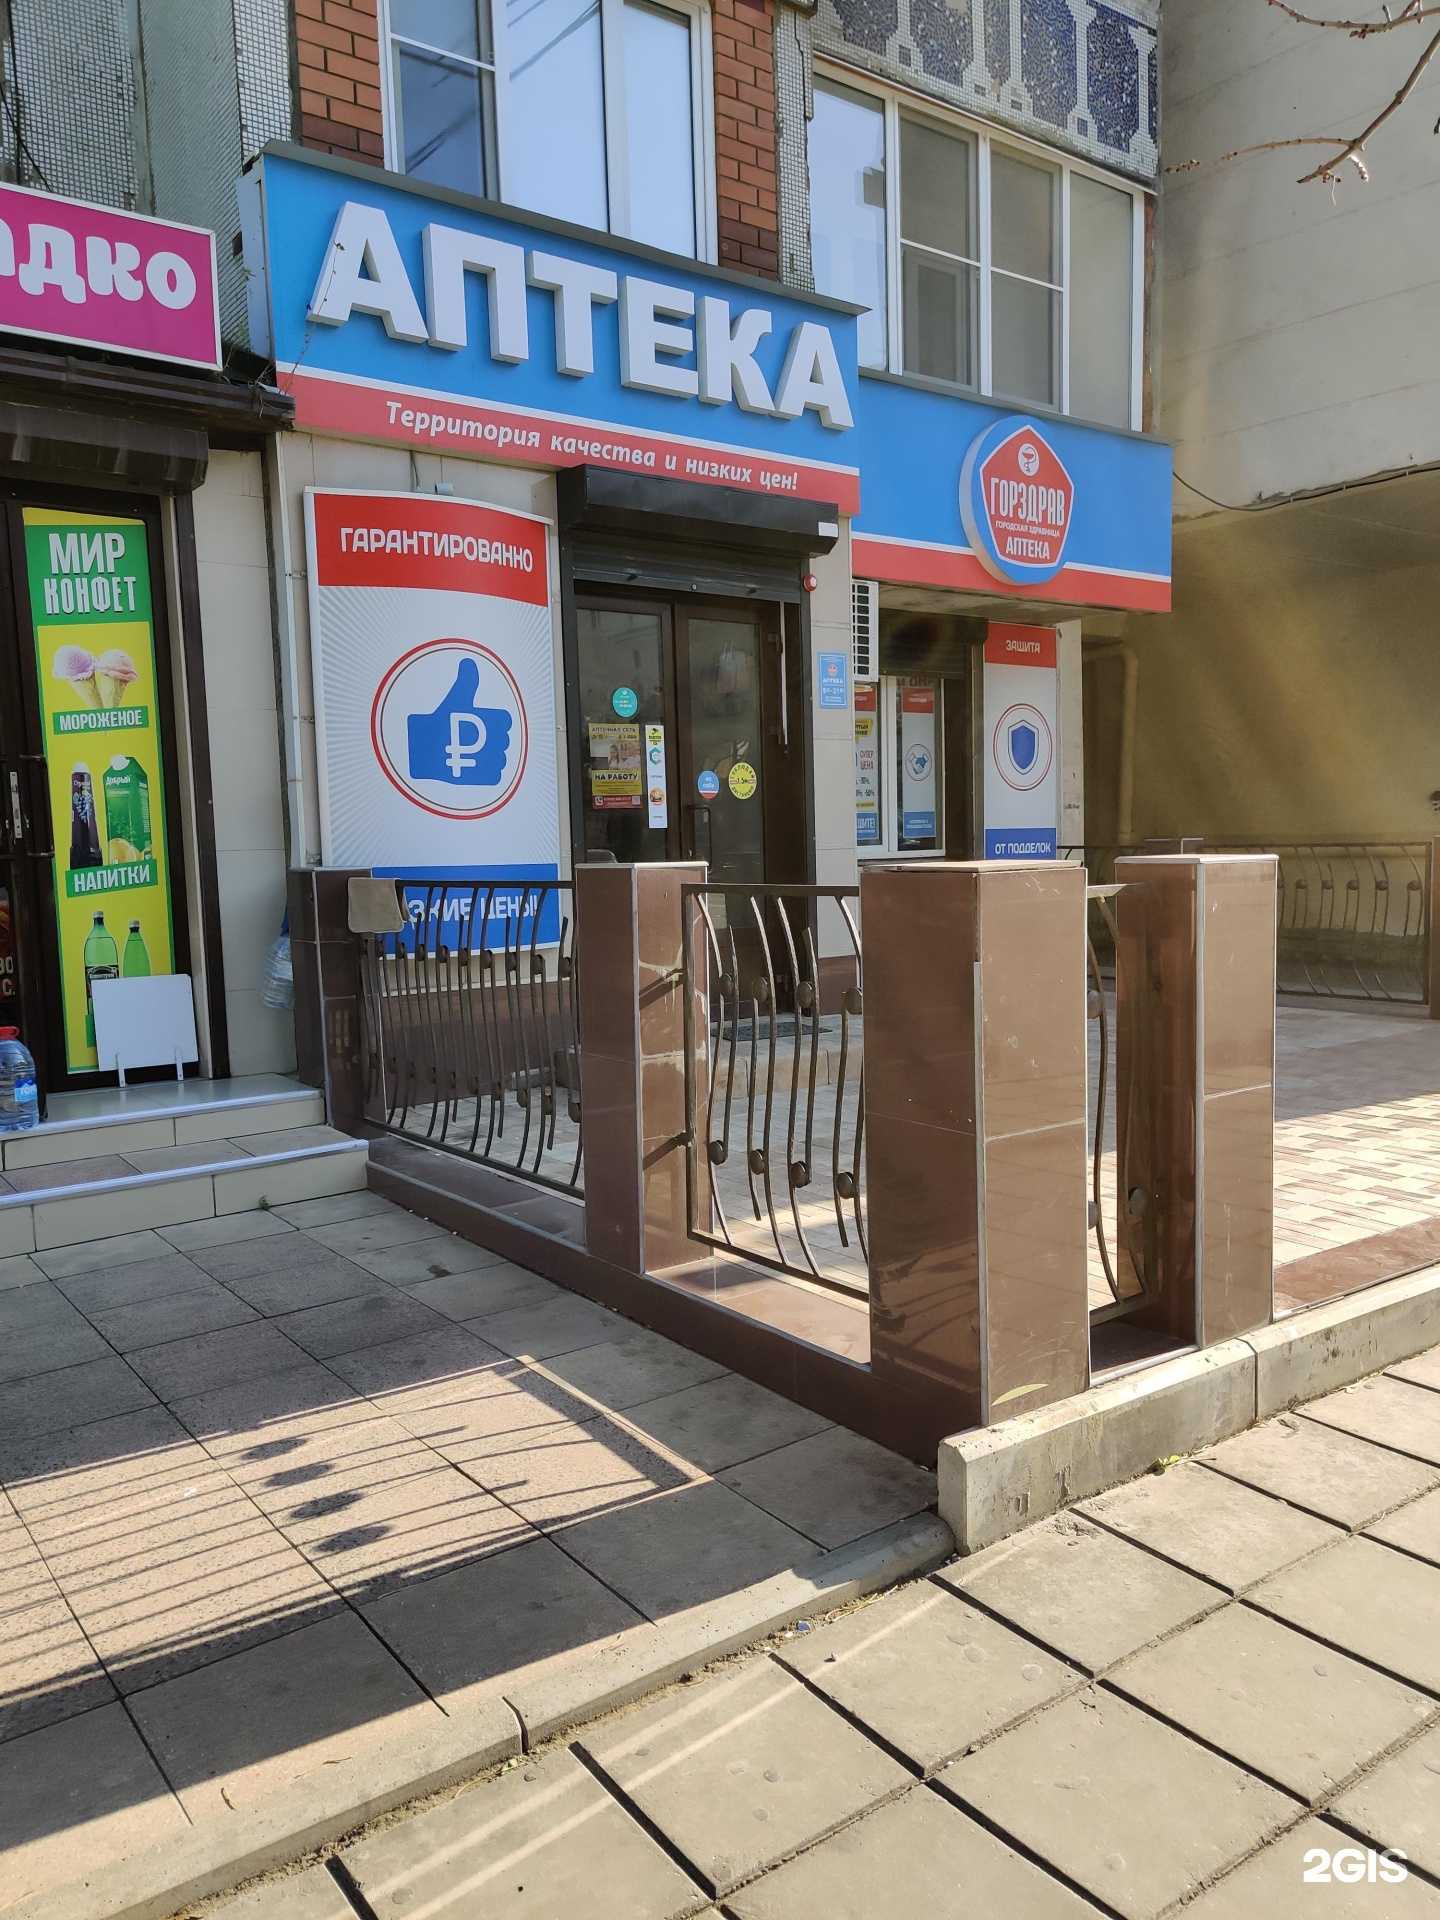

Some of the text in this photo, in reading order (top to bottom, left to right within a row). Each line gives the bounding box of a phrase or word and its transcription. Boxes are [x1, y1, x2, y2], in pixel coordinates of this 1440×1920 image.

[306, 201, 854, 431] АПТЕКА
[386, 400, 798, 491] Территория качества и низких цен!
[990, 477, 1065, 526] ГОРЗДРАВ
[995, 520, 1028, 533] ГОРОДСКАЯ
[48, 532, 126, 575] МИР
[340, 527, 533, 574] ГАРАНТИРОВАННО
[1005, 536, 1050, 560] АПТЕКА
[44, 576, 137, 615] КОНФЕТ
[1006, 639, 1041, 654] ЗАЩИТА
[59, 709, 142, 732] МОРОЖЕНОЕ
[607, 772, 638, 781] РАБОТУ
[995, 841, 1052, 855] ОТ ПОДДЕЛОК
[73, 862, 151, 893] НАПИТКИ
